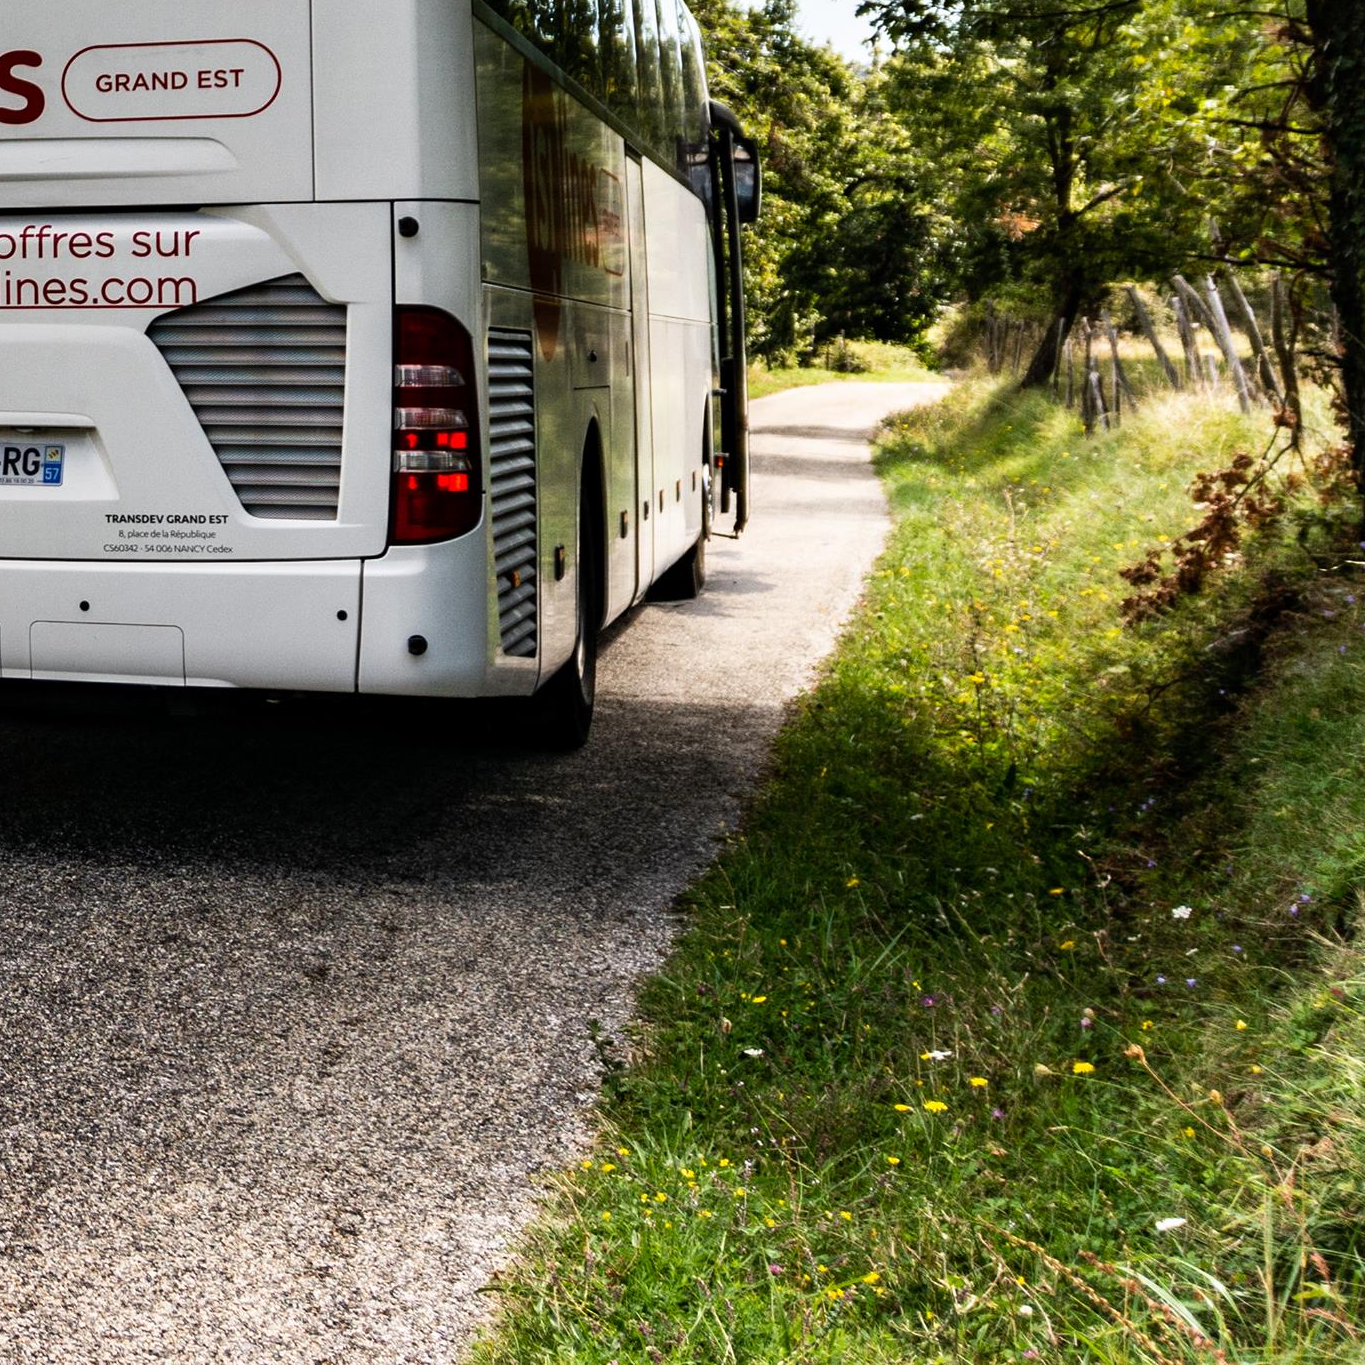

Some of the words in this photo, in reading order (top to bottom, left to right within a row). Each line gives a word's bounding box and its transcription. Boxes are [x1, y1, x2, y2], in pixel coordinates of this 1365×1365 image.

[95, 71, 188, 93] GRAND
[198, 68, 245, 89] EST
[131, 229, 200, 257] sur
[44, 467, 60, 479] 57
[105, 514, 164, 524] TRANSDEV
[166, 514, 206, 524] GRAND
[208, 514, 229, 524] EST
[118, 529, 126, 539] 8,
[127, 529, 149, 539] place
[150, 529, 161, 538] de
[162, 529, 169, 538] la
[170, 529, 216, 540] République
[103, 543, 139, 553] CS60342
[144, 544, 155, 552] 54
[174, 544, 205, 553] NANCY
[206, 544, 234, 554] Cedex
